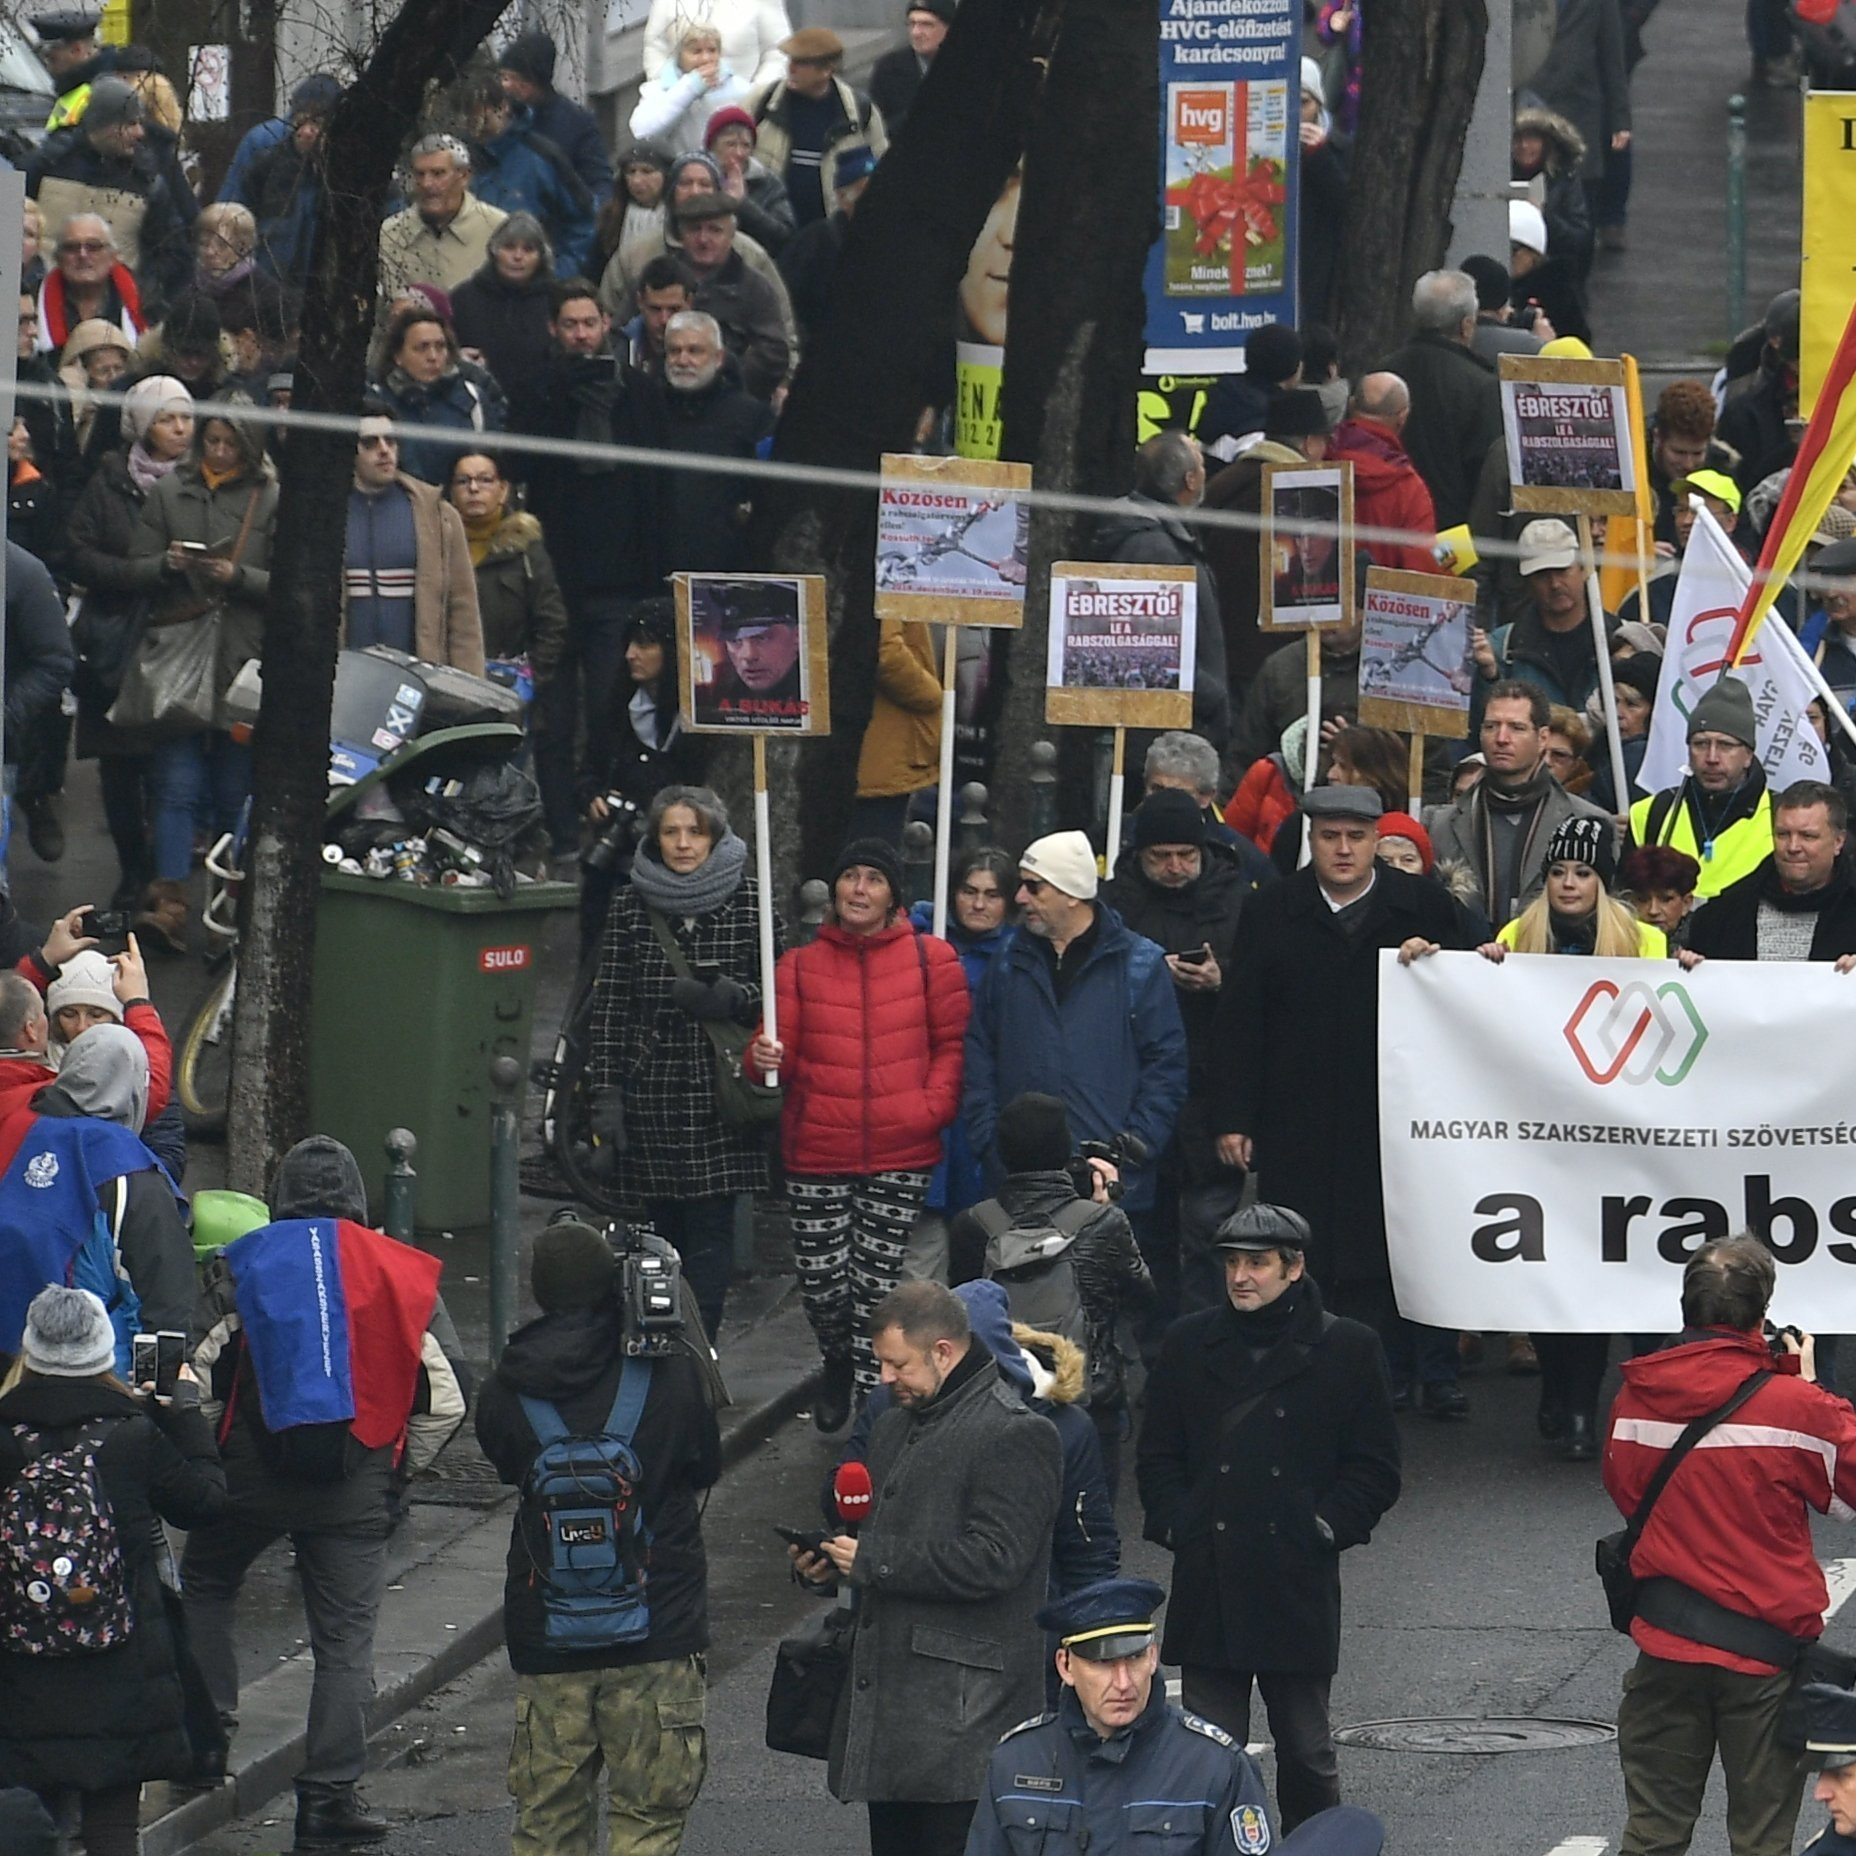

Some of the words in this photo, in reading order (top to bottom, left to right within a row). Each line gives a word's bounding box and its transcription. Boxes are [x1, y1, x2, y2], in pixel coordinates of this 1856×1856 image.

[1160, 18, 1292, 40] HVG-előfizetést
[1174, 42, 1286, 65] karácsonyra!
[1181, 103, 1222, 132] hvg
[1517, 393, 1609, 418] ÉBRESZTŐ!
[1555, 424, 1566, 436] LE
[1567, 425, 1574, 436] A
[1068, 591, 1178, 616] ÉBRESZTŐ!
[1367, 593, 1430, 618] Közösen
[1067, 633, 1178, 647] RABSZOLGASÁGGAL!
[1110, 623, 1122, 635] LE
[1124, 623, 1132, 635] A
[485, 949, 524, 967] SULO
[1410, 1120, 1509, 1141] MAGYAR
[1518, 1121, 1718, 1148] SZAKSZERVEZETI
[1471, 1193, 1548, 1263] a
